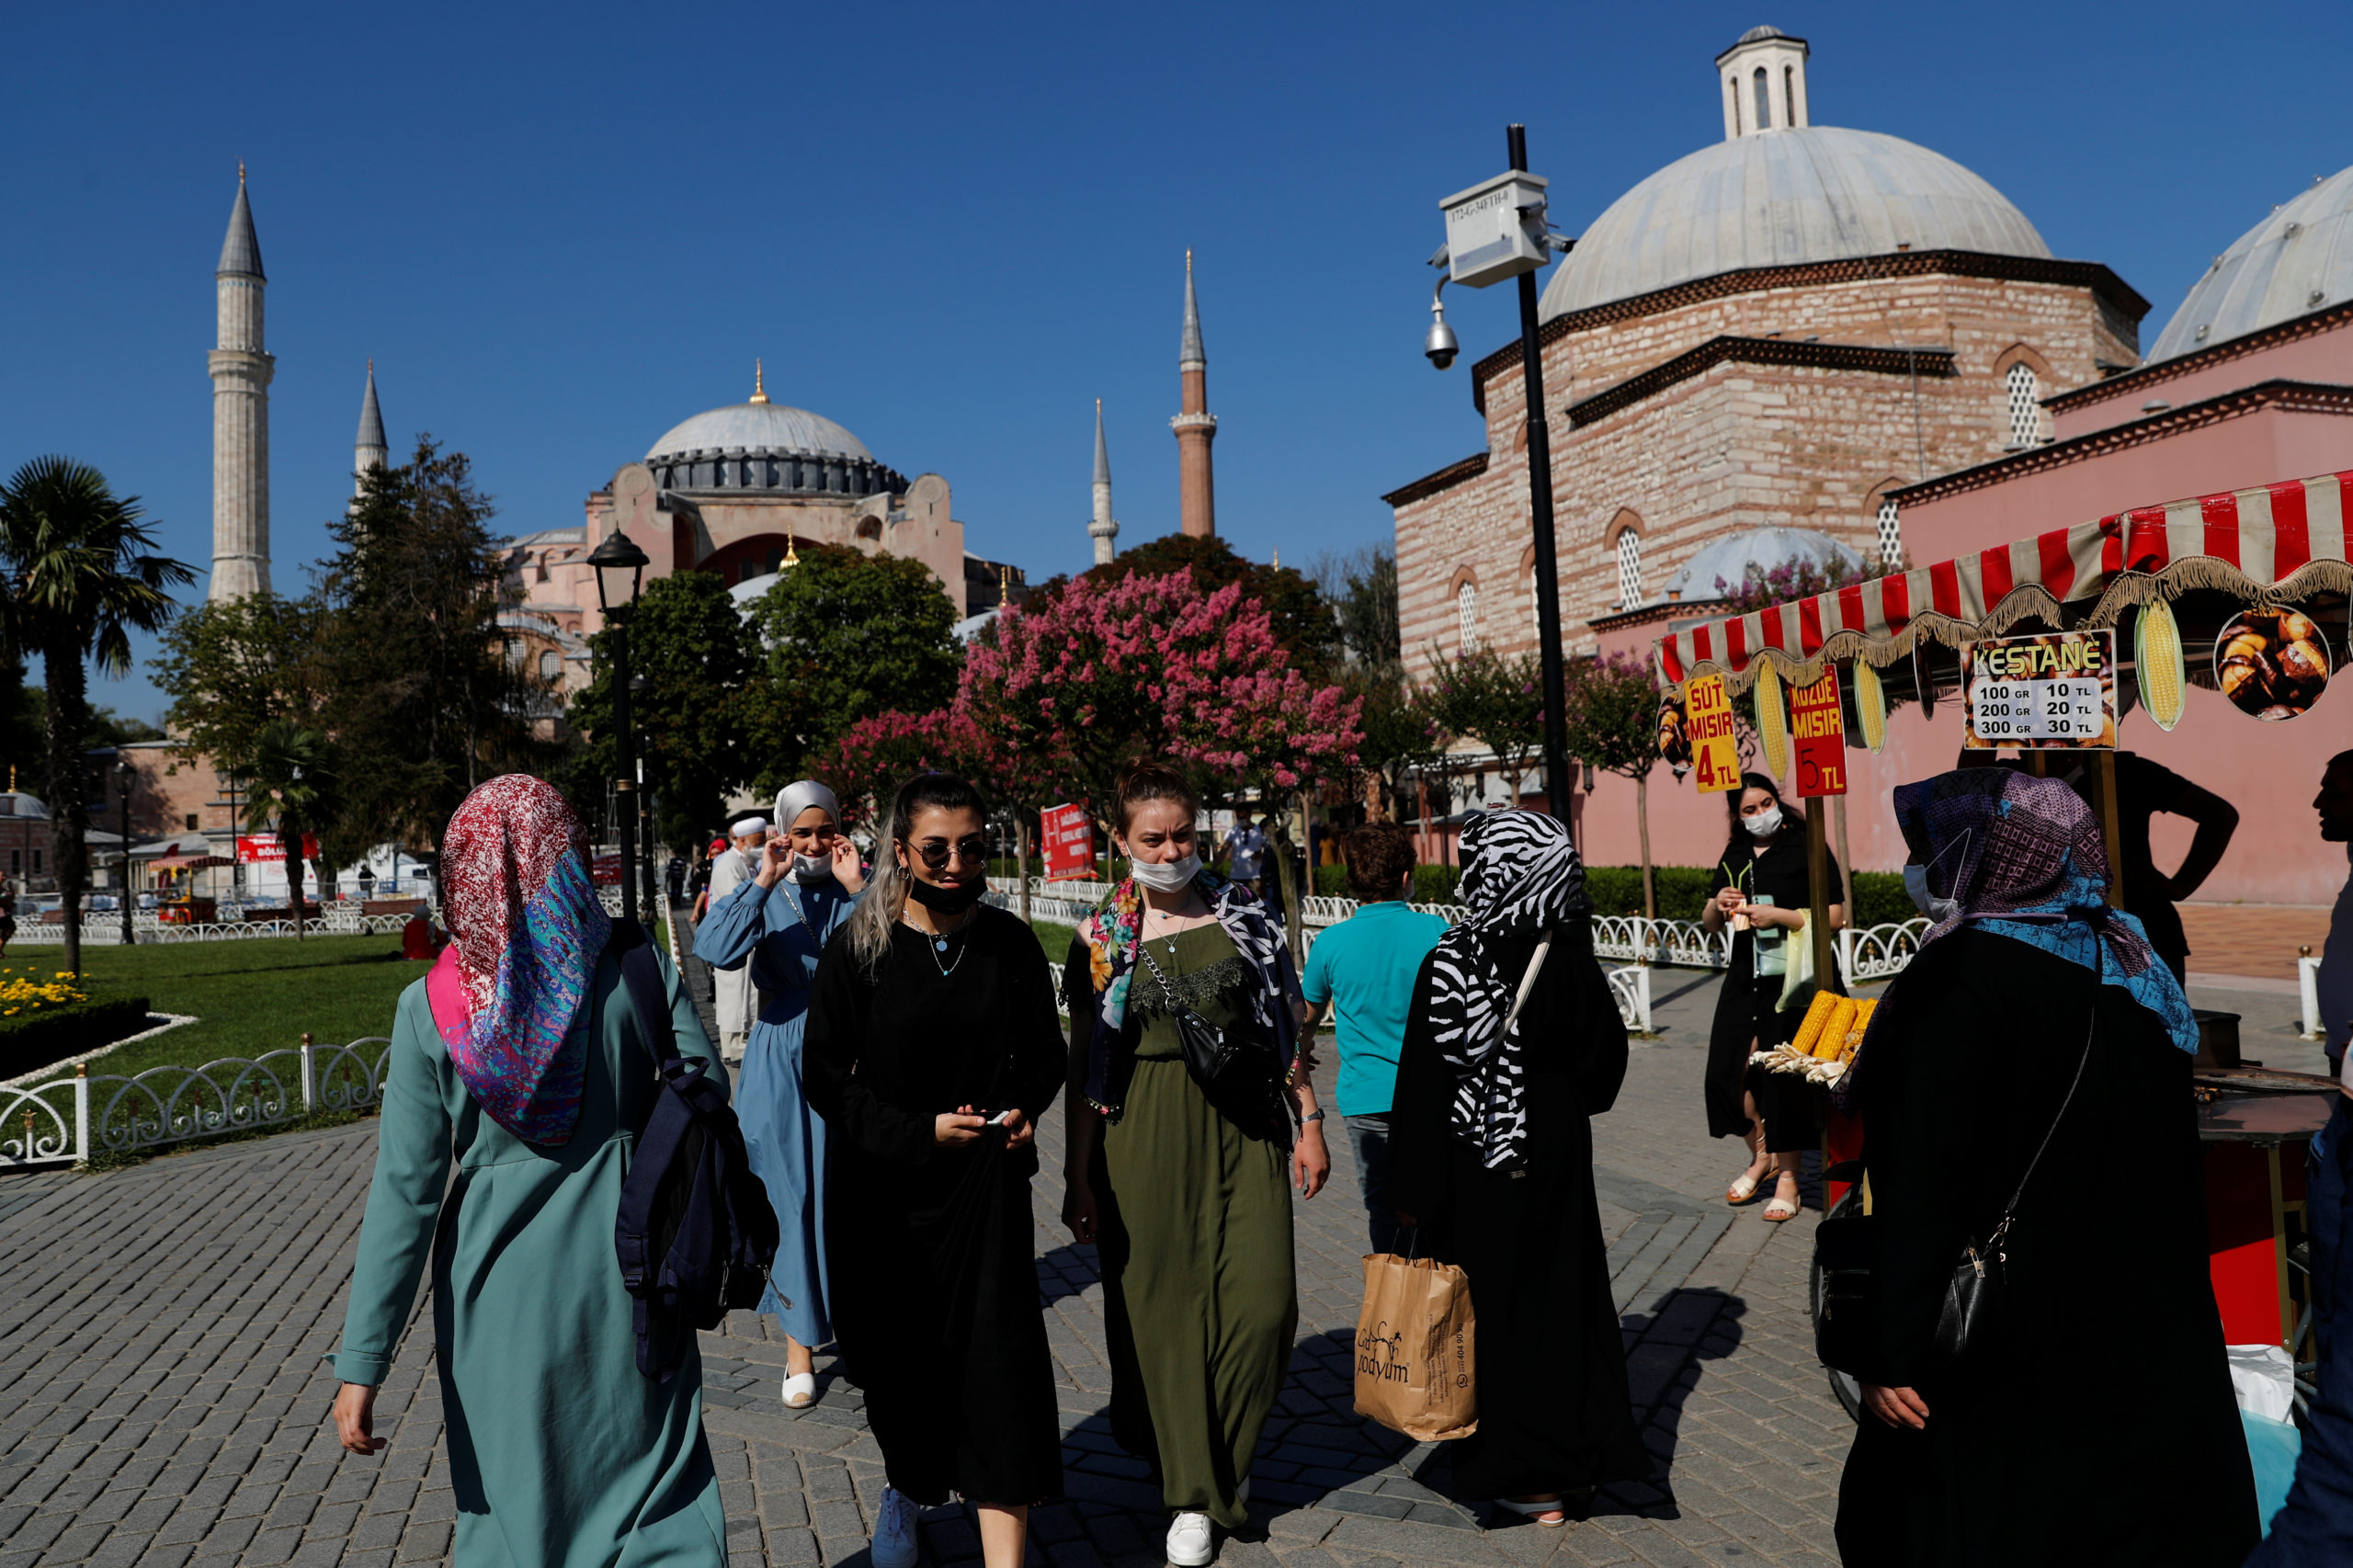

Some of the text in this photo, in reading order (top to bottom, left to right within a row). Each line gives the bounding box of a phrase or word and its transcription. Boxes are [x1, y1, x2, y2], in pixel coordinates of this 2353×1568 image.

[1973, 641, 2101, 676] KESTANE
[1691, 682, 1722, 712] SÜT
[1980, 684, 2091, 699] 100 GR 10 TL
[1792, 707, 1842, 740] MISIR
[1981, 701, 2092, 717] 200 GR 20 TL
[1689, 711, 1733, 742] MISIR
[1982, 720, 2092, 733] 300 GR 30 TL
[1698, 744, 1737, 787] 4 TL
[1800, 748, 1844, 790] 5 TL
[1457, 1334, 1463, 1344] 90
